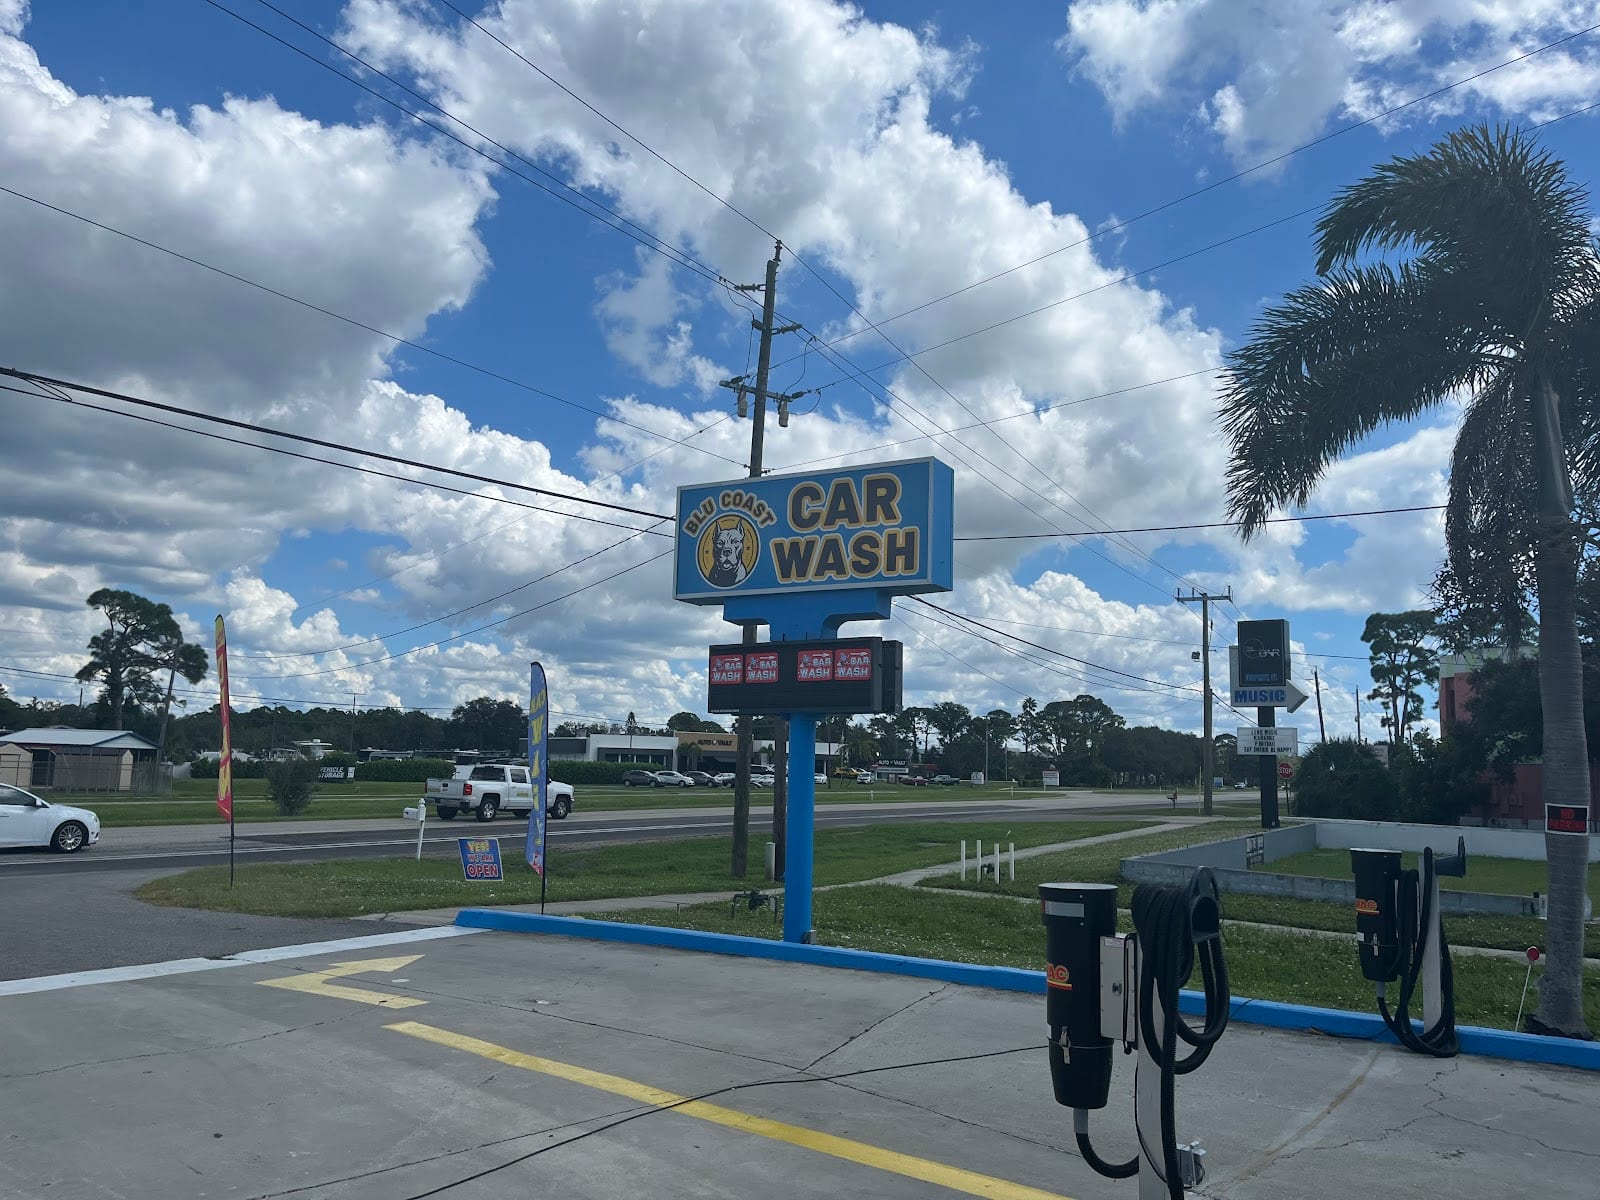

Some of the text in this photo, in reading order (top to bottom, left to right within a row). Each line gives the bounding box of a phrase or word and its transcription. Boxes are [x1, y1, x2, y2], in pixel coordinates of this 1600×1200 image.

[787, 473, 902, 532] CAR
[682, 489, 777, 537] BLU COAST
[770, 527, 920, 583] WASH
[760, 661, 777, 669] CAR
[813, 658, 832, 666] CAR
[850, 656, 870, 665] CAR
[724, 662, 742, 670] CAR
[713, 671, 741, 681] WASH
[748, 670, 776, 680] WASH
[800, 668, 830, 678] WASH
[837, 667, 868, 677] WASH
[1234, 689, 1286, 703] MUSIC
[467, 863, 499, 877] OPEN
[1355, 898, 1377, 911] AC
[1047, 963, 1069, 982] AC
